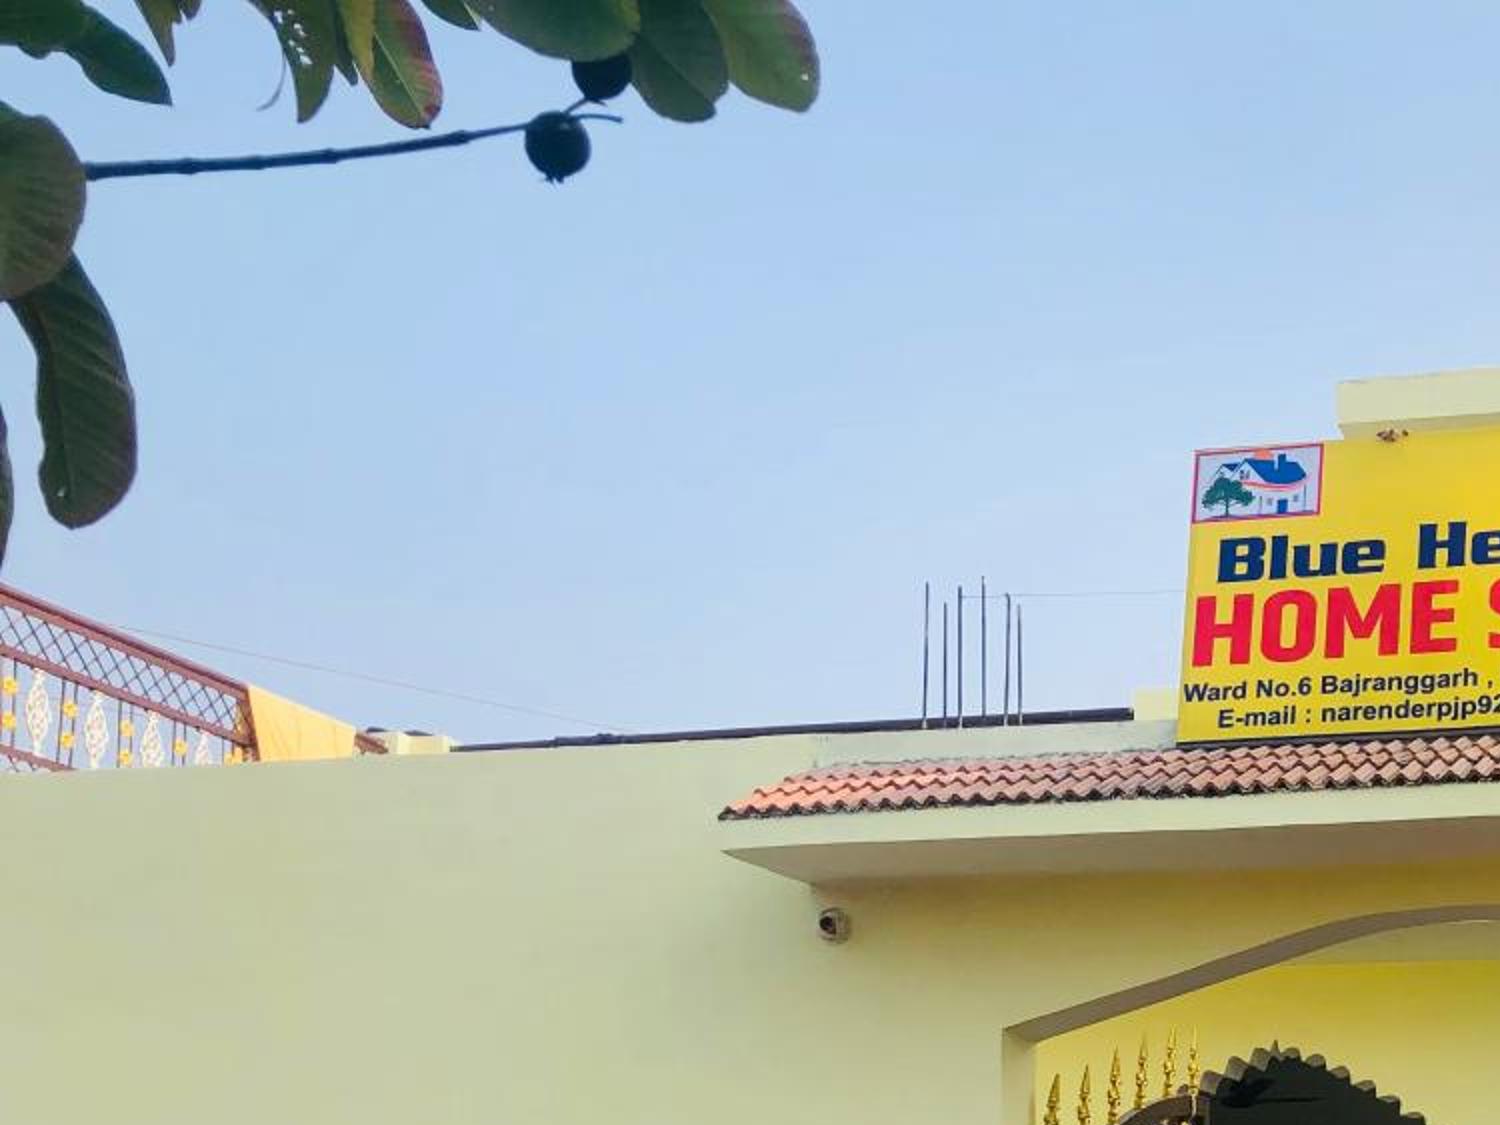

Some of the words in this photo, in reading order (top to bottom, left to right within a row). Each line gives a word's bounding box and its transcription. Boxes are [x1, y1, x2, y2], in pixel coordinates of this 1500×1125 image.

[1217, 535, 1386, 583] Blue
[1191, 580, 1460, 667] HOME
[1183, 681, 1248, 703] Ward
[1256, 676, 1312, 699] No.6
[1321, 668, 1478, 697] Bajranggarh
[1217, 706, 1297, 729] E-mail
